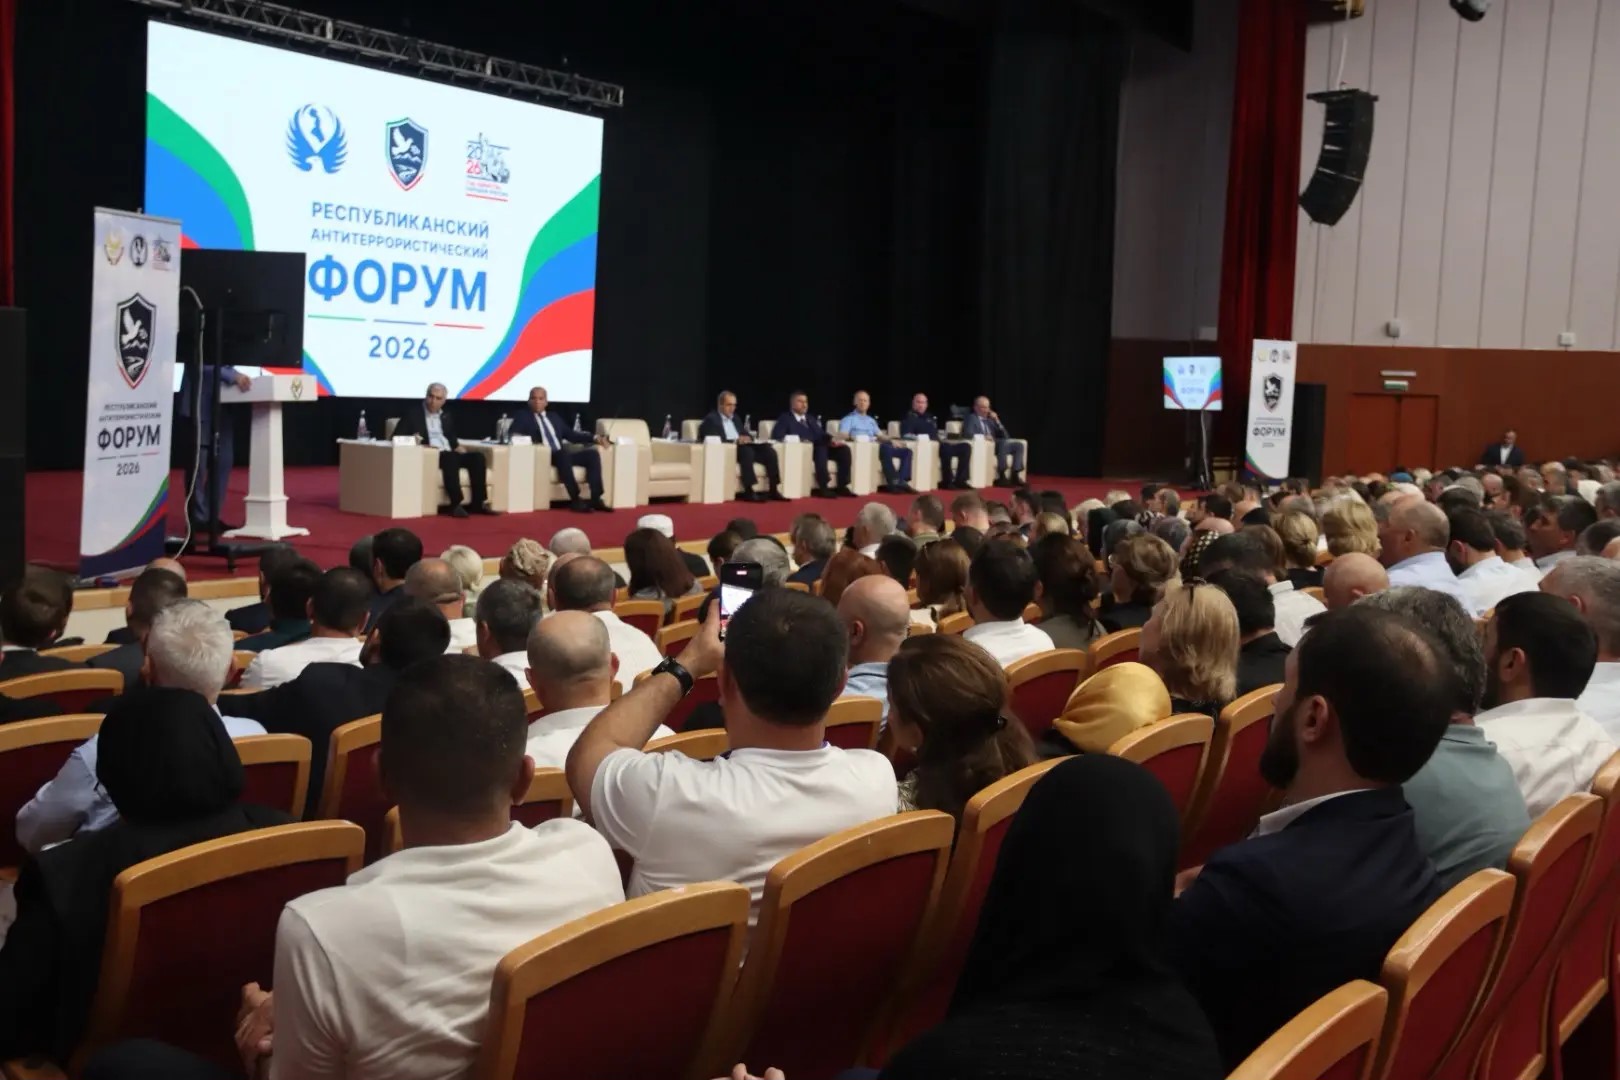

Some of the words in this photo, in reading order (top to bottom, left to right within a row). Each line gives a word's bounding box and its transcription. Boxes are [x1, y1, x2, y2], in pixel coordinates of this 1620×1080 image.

[467, 159, 481, 174] 26
[312, 201, 489, 238] РЕСПУБЛИКАНСКИЙ
[311, 228, 488, 259] АНТИТЕРРОРИСТИЧЕСКИЙ
[308, 254, 487, 312] ФОРУМ
[369, 335, 431, 360] 2026
[98, 424, 161, 450] ФОРУМ
[1252, 427, 1286, 437] ФОРУМ
[116, 462, 140, 476] 2026
